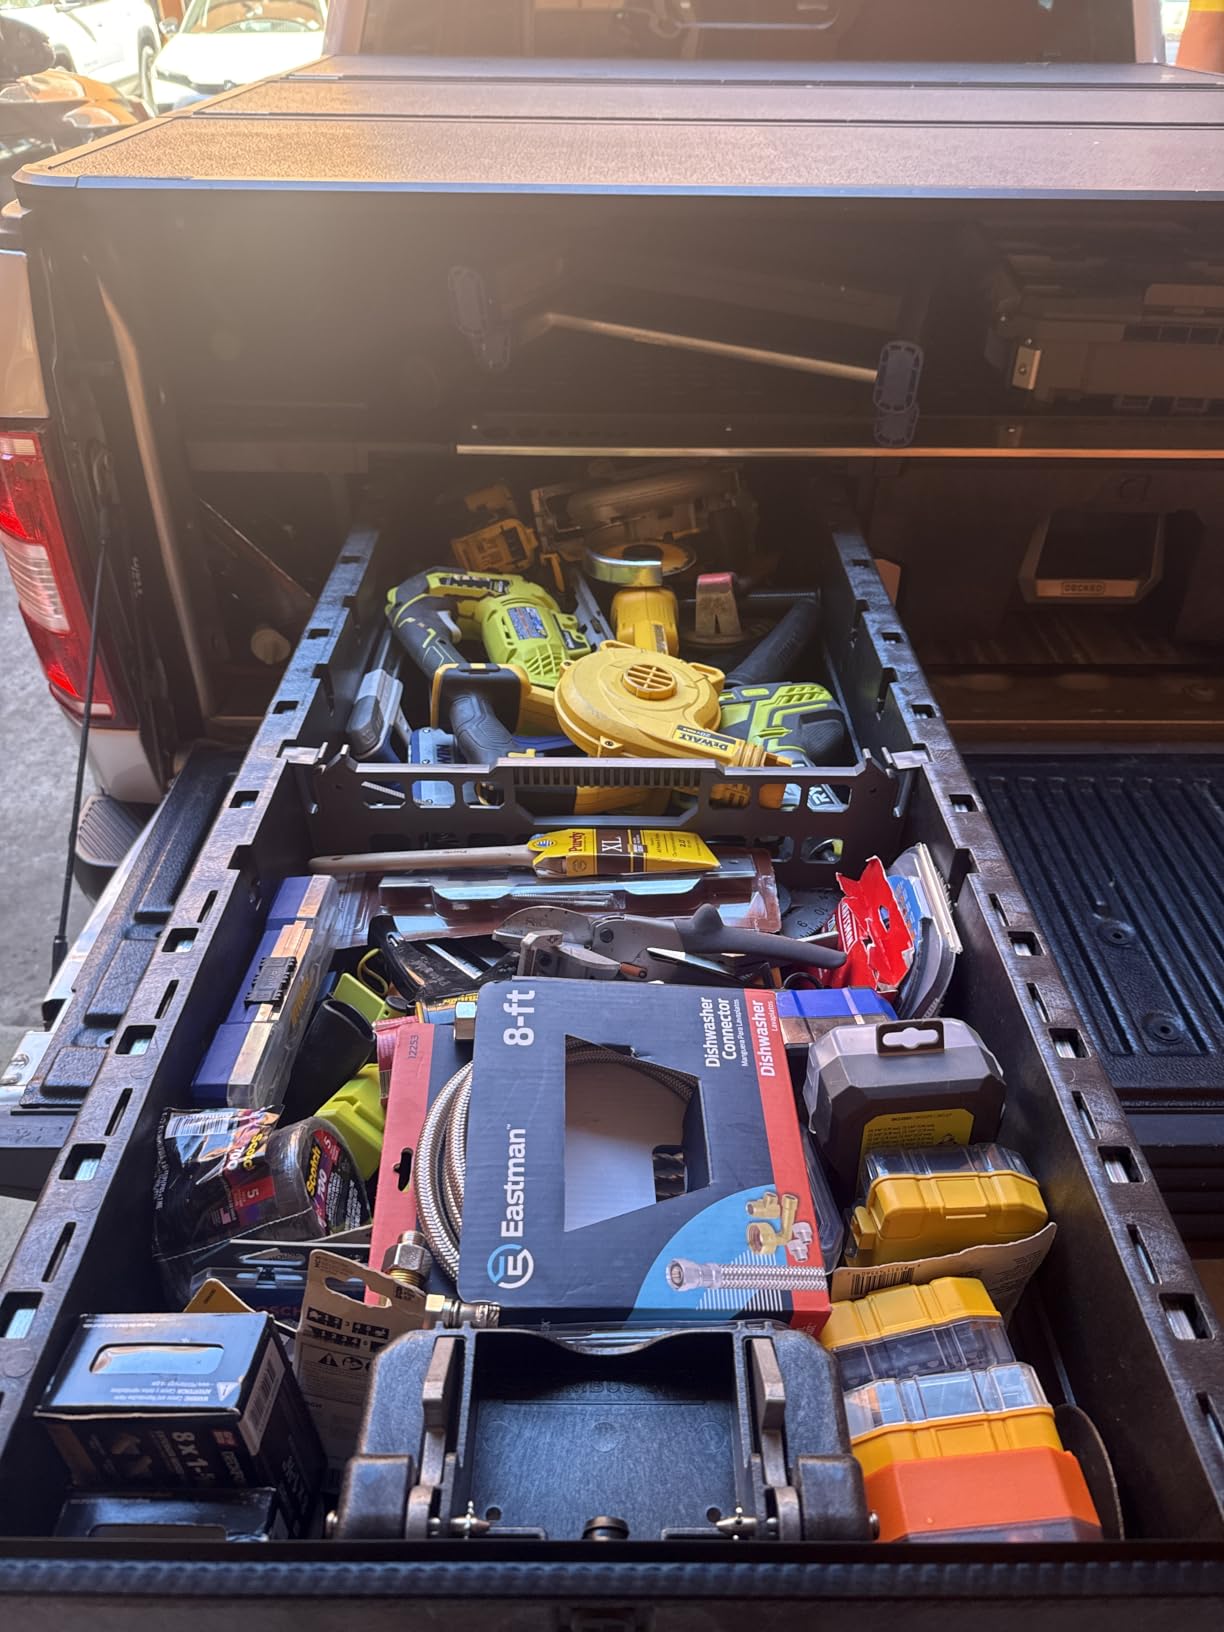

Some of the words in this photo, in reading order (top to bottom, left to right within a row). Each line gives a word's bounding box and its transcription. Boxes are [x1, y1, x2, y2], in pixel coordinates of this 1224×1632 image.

[679, 731, 728, 752] DEWALT
[568, 831, 585, 853] Purdy
[601, 836, 623, 853] XL
[503, 989, 536, 1046] 8-ft
[734, 999, 743, 1027] Lavaplatos
[767, 1000, 778, 1032] Lavaplatos
[699, 997, 721, 1068] Dishwasher
[717, 997, 737, 1060] Connector
[737, 1026, 745, 1040] Para
[752, 999, 776, 1077] Dishwasher
[407, 1034, 418, 1059] 12253
[740, 1040, 749, 1067] Manguera
[323, 1135, 332, 1149] 5
[306, 1144, 321, 1196] Scotch
[501, 1128, 527, 1238] Eastman
[246, 1187, 260, 1198] 5
[317, 1168, 327, 1201] 700
[172, 1431, 195, 1442] 8
